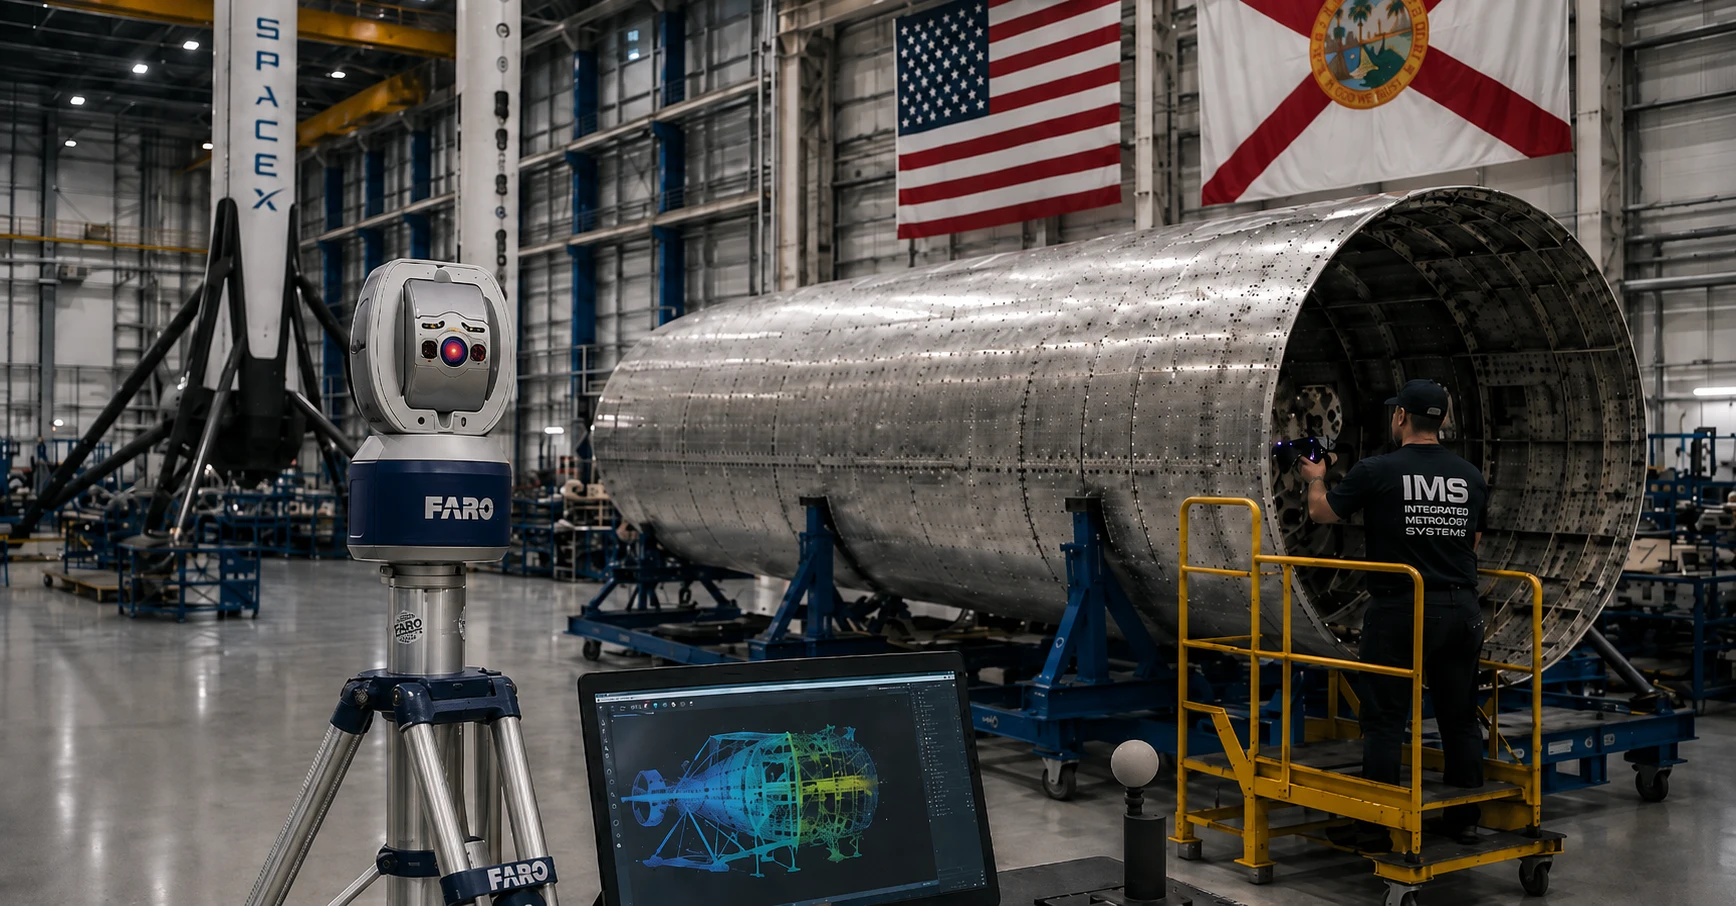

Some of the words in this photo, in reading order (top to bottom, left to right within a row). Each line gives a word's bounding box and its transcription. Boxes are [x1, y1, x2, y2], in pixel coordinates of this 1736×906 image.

[252, 16, 286, 212] SPACEX
[1402, 474, 1469, 504] IMS
[424, 496, 494, 520] FARO
[1404, 505, 1469, 516] INTEGRATED
[1405, 516, 1468, 527] METROLOGY
[394, 618, 423, 637] FARO
[487, 860, 549, 891] FARO
